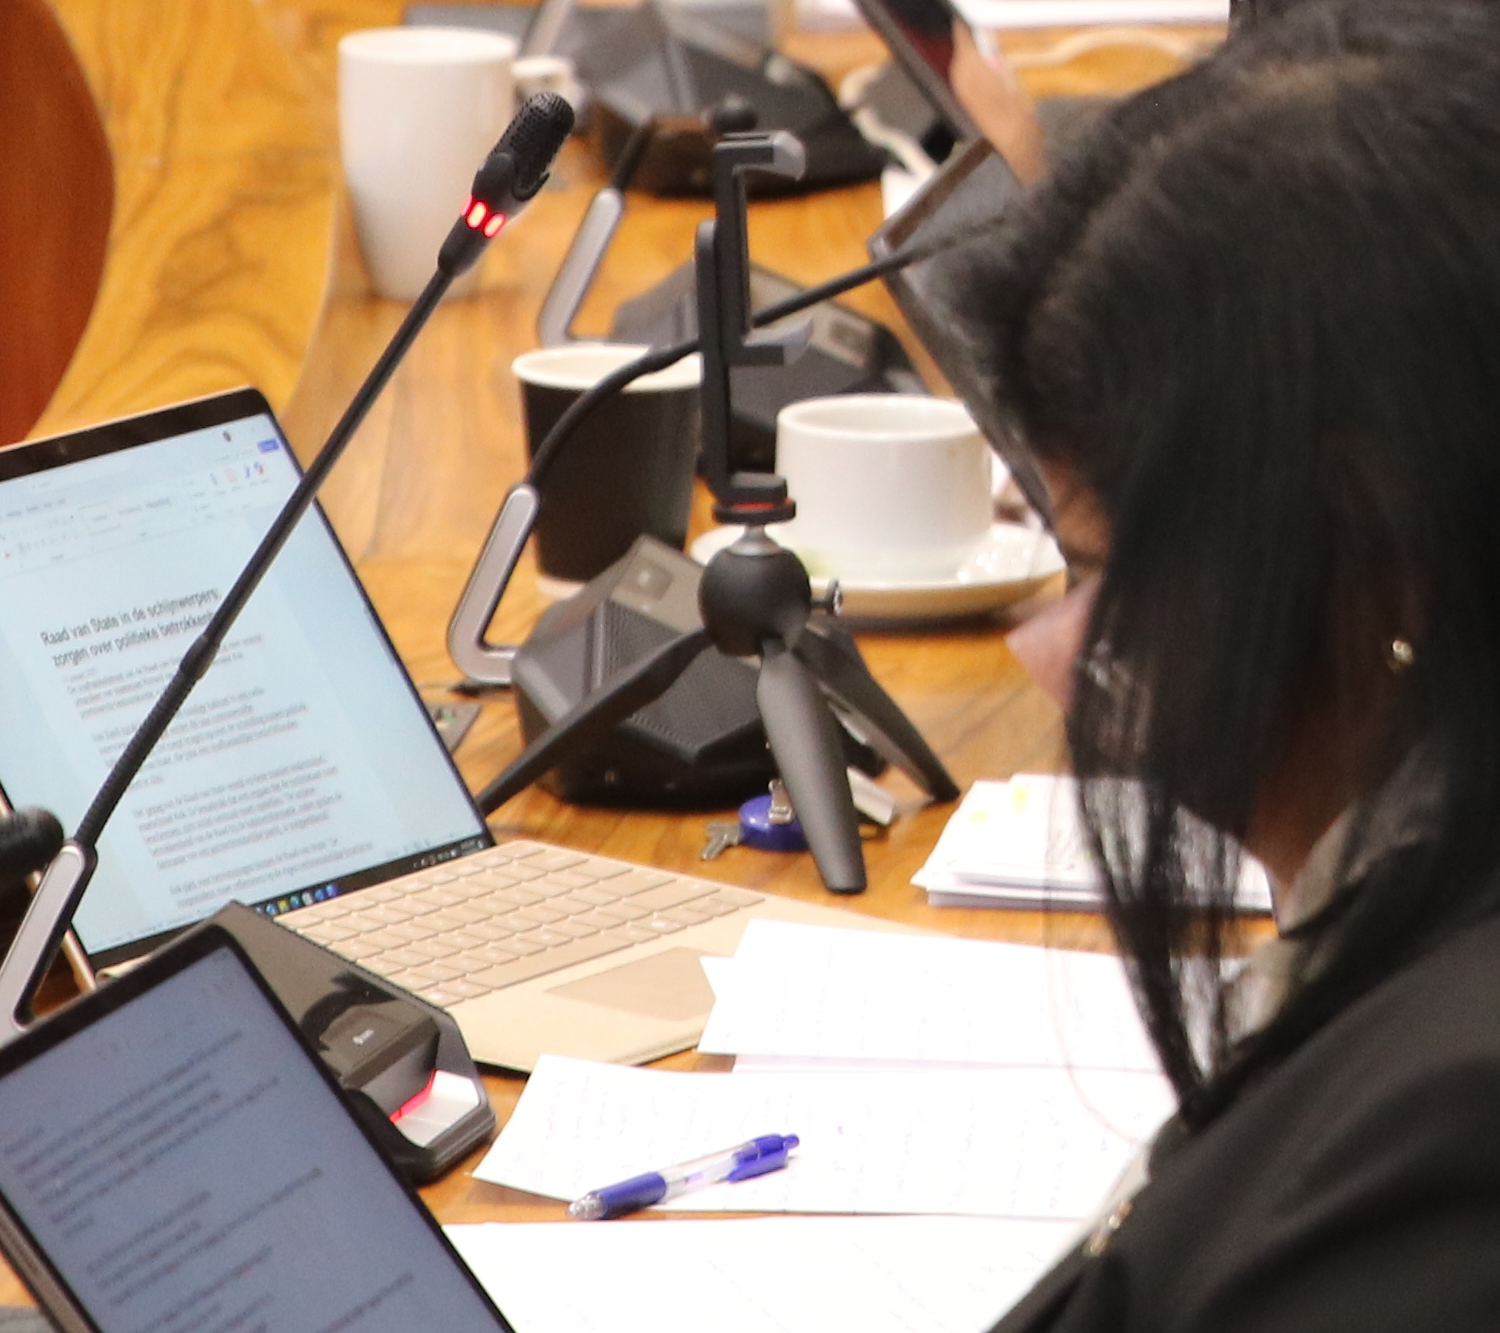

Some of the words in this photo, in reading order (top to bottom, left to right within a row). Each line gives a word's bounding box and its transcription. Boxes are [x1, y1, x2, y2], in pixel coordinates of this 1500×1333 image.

[40, 627, 70, 647] Raad
[71, 624, 91, 640] van
[90, 616, 119, 633] State
[119, 612, 132, 624] in
[132, 608, 146, 622] de
[52, 648, 89, 667] zorgen
[90, 640, 113, 656] over
[114, 627, 159, 652] politieke
